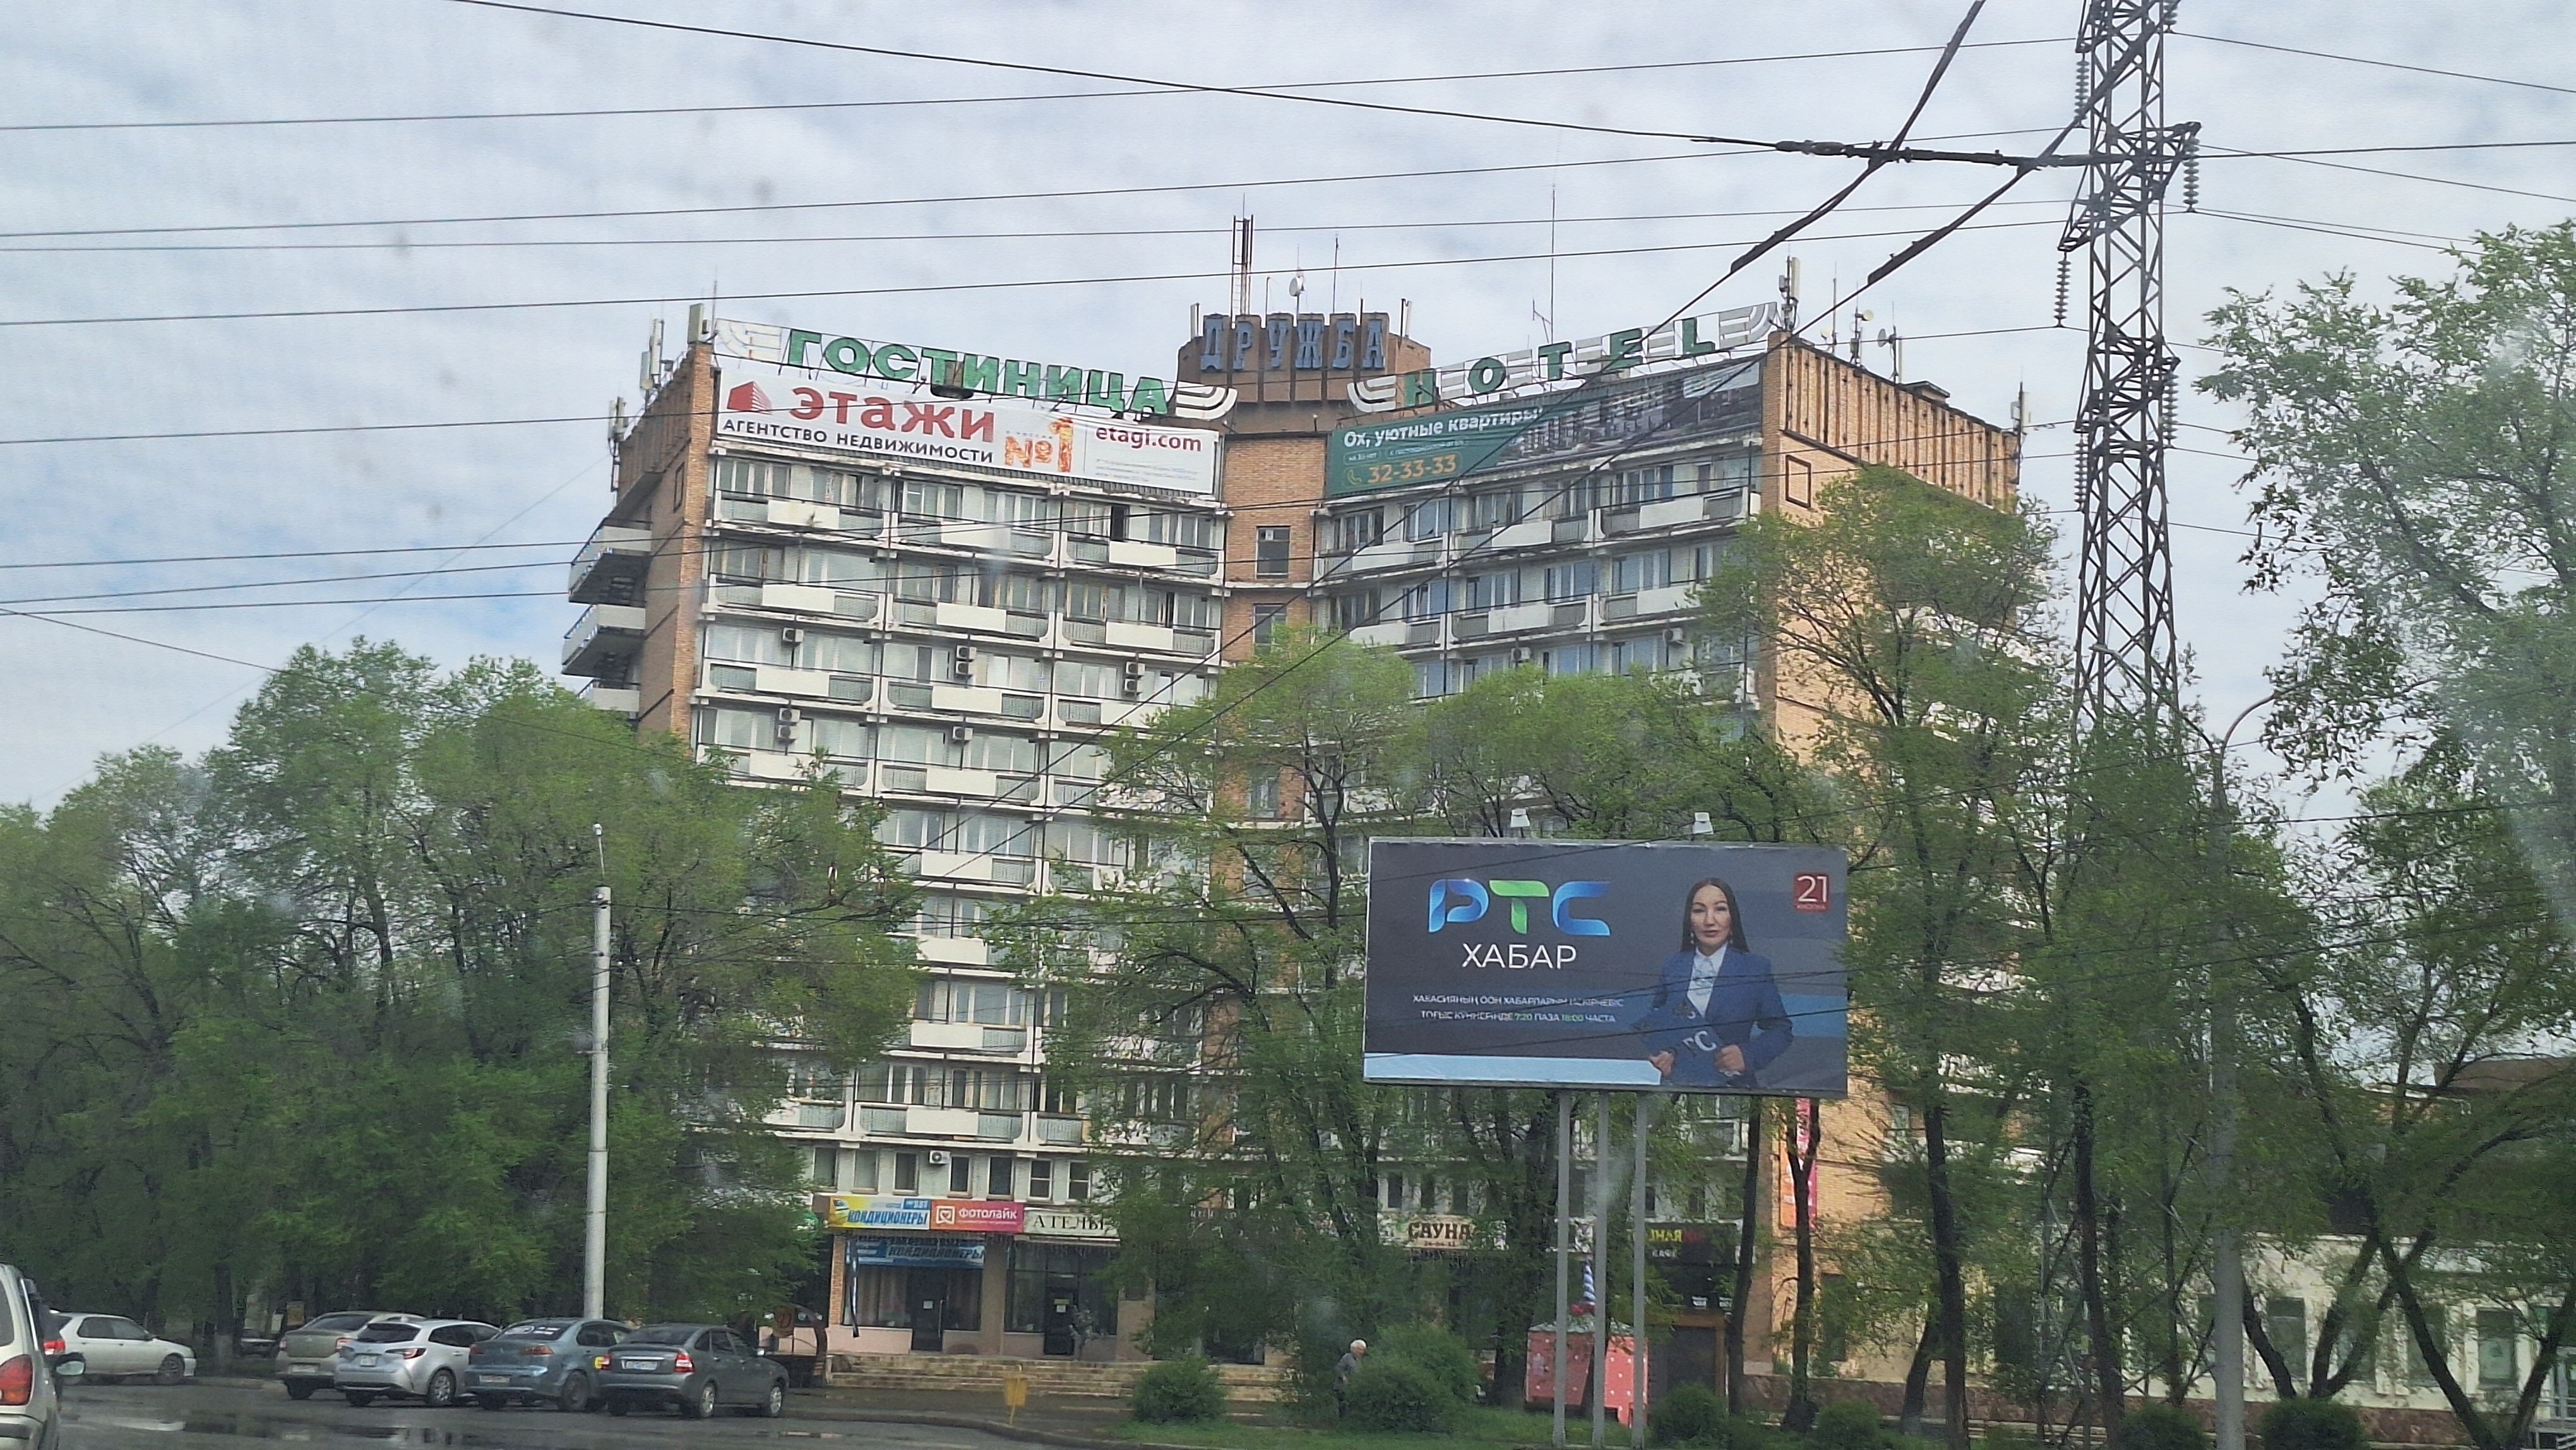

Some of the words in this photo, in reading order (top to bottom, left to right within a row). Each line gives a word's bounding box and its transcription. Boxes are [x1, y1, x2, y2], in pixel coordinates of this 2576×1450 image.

[1200, 316, 1386, 371] ДРУЖБА
[787, 328, 1168, 416] ГОСТИНИЦА
[1404, 316, 1715, 407] HOTEL
[722, 419, 827, 443] АГЕНТСТВО
[837, 432, 993, 464] НЕДВИЖИМОСТИ
[1095, 426, 1202, 452] etagi.com
[1374, 419, 1443, 448] уютные
[1367, 453, 1457, 484] 32-33-33
[1797, 875, 1827, 902] 21
[1428, 878, 1611, 937] РТС
[1462, 943, 1577, 969] ХАБАР
[847, 1209, 929, 1226] КОНДИЦИОНЕРЫ
[1408, 1222, 1472, 1240] САУНА
